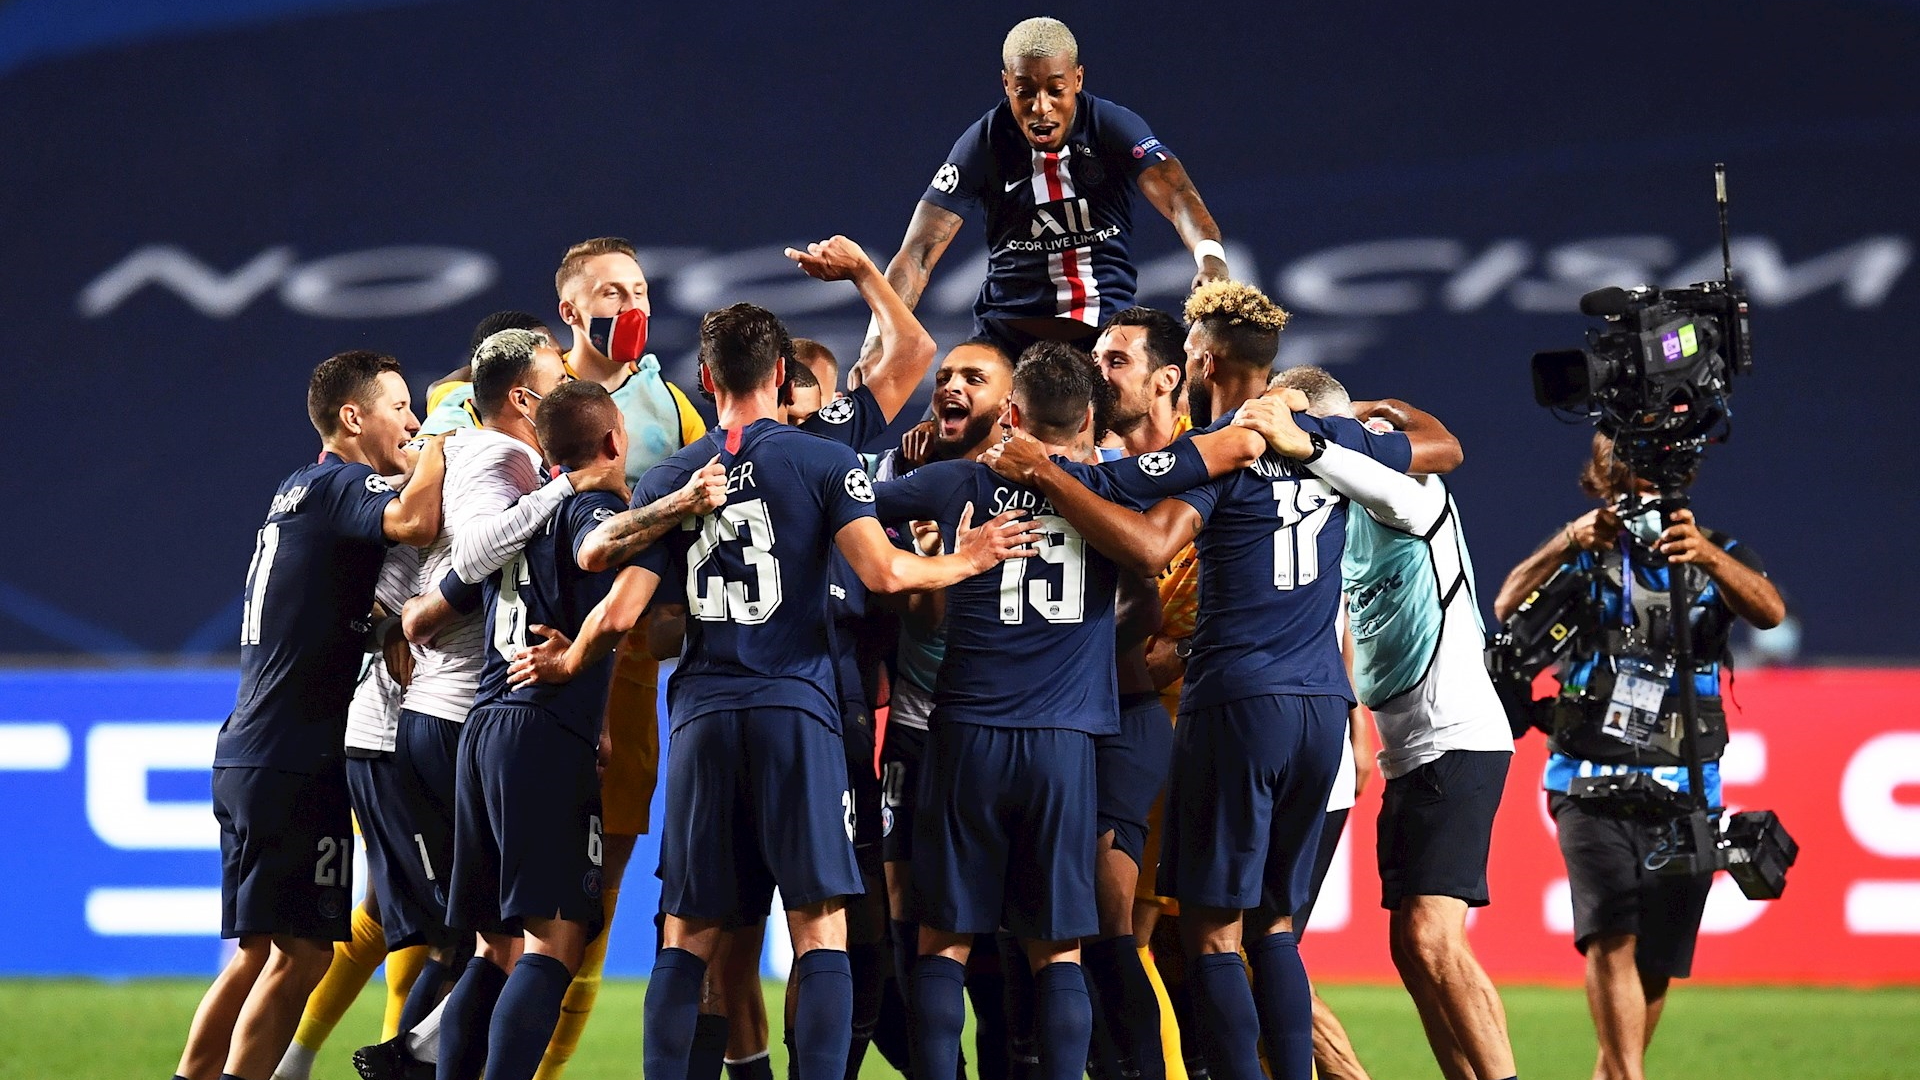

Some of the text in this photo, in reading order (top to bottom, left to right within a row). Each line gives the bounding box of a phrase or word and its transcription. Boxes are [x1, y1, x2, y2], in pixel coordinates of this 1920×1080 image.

[1044, 237, 1071, 251] LIVE
[78, 242, 500, 320] NO
[682, 498, 783, 626] 23
[1000, 514, 1087, 626] 19
[314, 836, 350, 888] 21
[414, 832, 436, 881] 1
